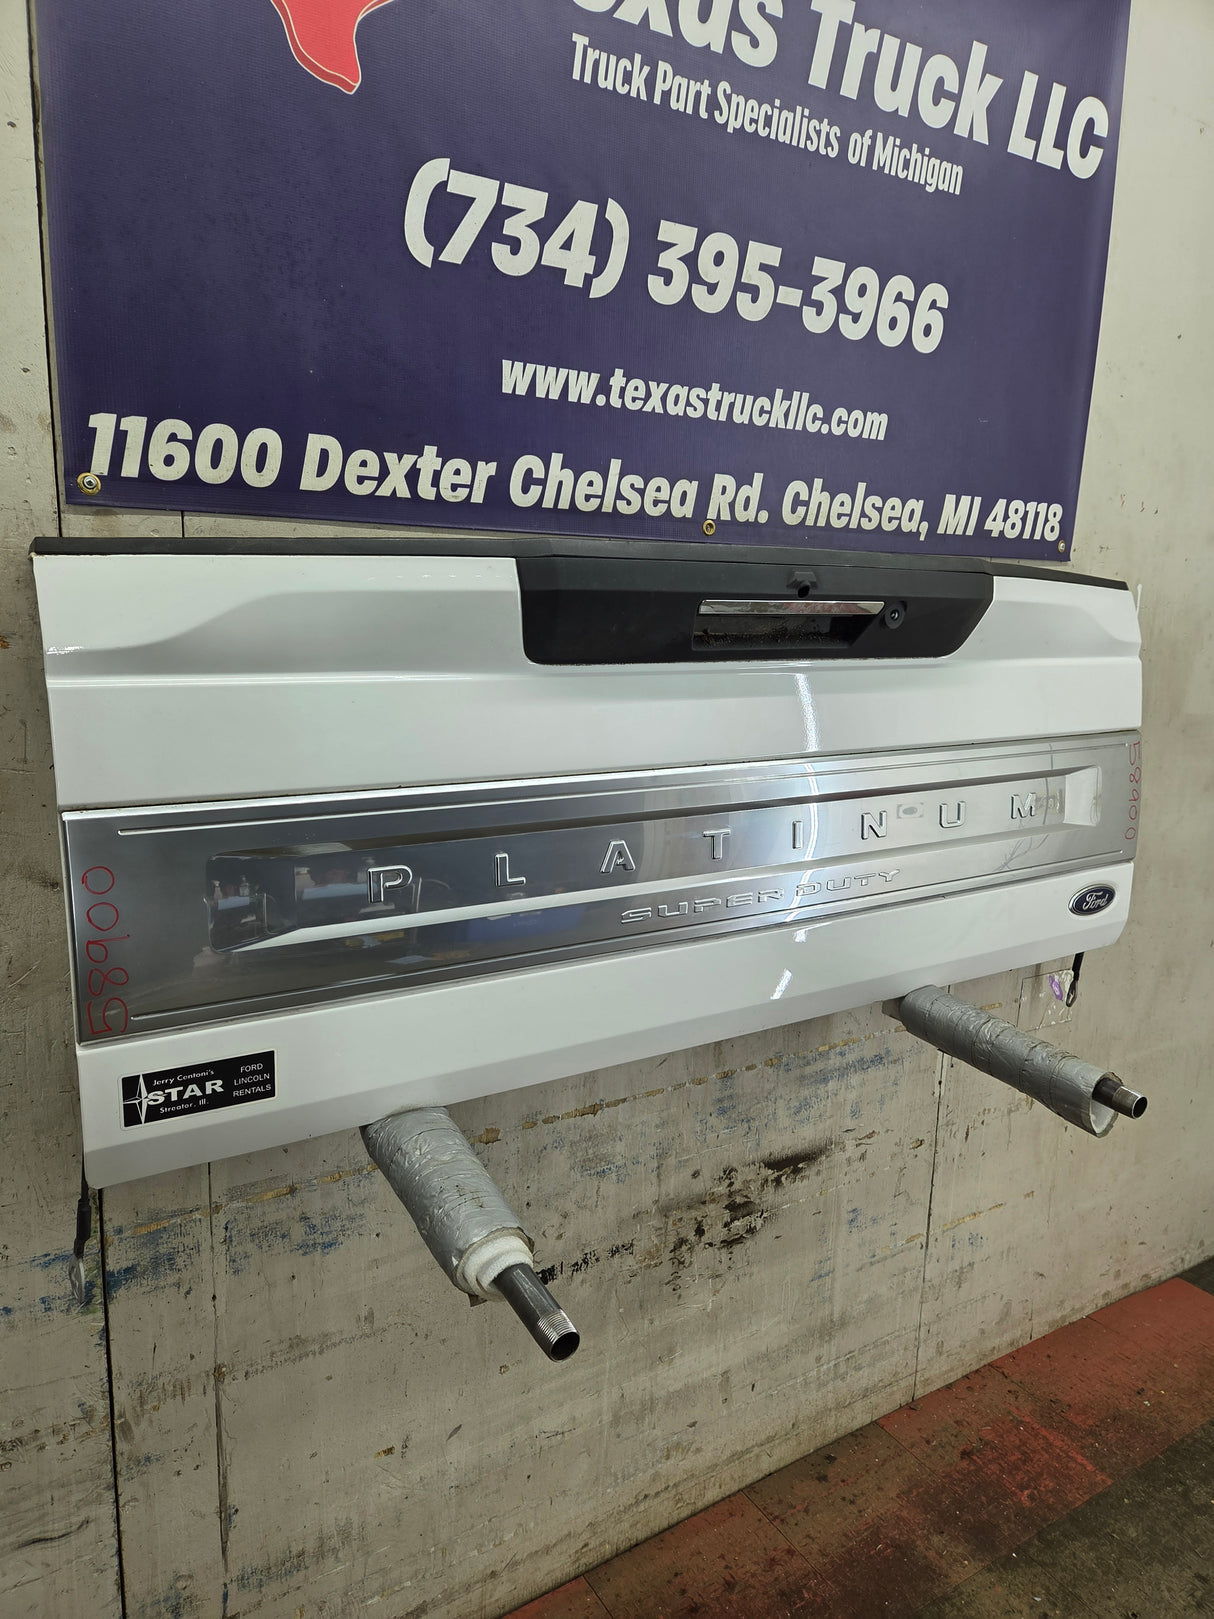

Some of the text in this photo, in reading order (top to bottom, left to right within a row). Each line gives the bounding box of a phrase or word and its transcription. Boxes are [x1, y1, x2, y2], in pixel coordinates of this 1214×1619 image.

[571, 32, 964, 196] Truck Part Specialists of Michigan
[807, 0, 1004, 146] Truck
[1006, 70, 1109, 180] LLC
[404, 157, 949, 354] (734) 395-3966
[501, 359, 889, 441] www.texastruckllc.com
[88, 412, 1063, 542] 11600 Dexter Chelsea Rd. Chelsea, MI 48118
[367, 791, 1038, 904] PLATINUM
[621, 868, 901, 924] SUPER DUTY
[81, 865, 130, 1035] 58900
[147, 1079, 224, 1106] STAR
[153, 1077, 175, 1087] Jerry
[232, 1083, 272, 1098] RENTALS
[233, 1073, 270, 1086] LINCOLN
[240, 1063, 264, 1073] FORD
